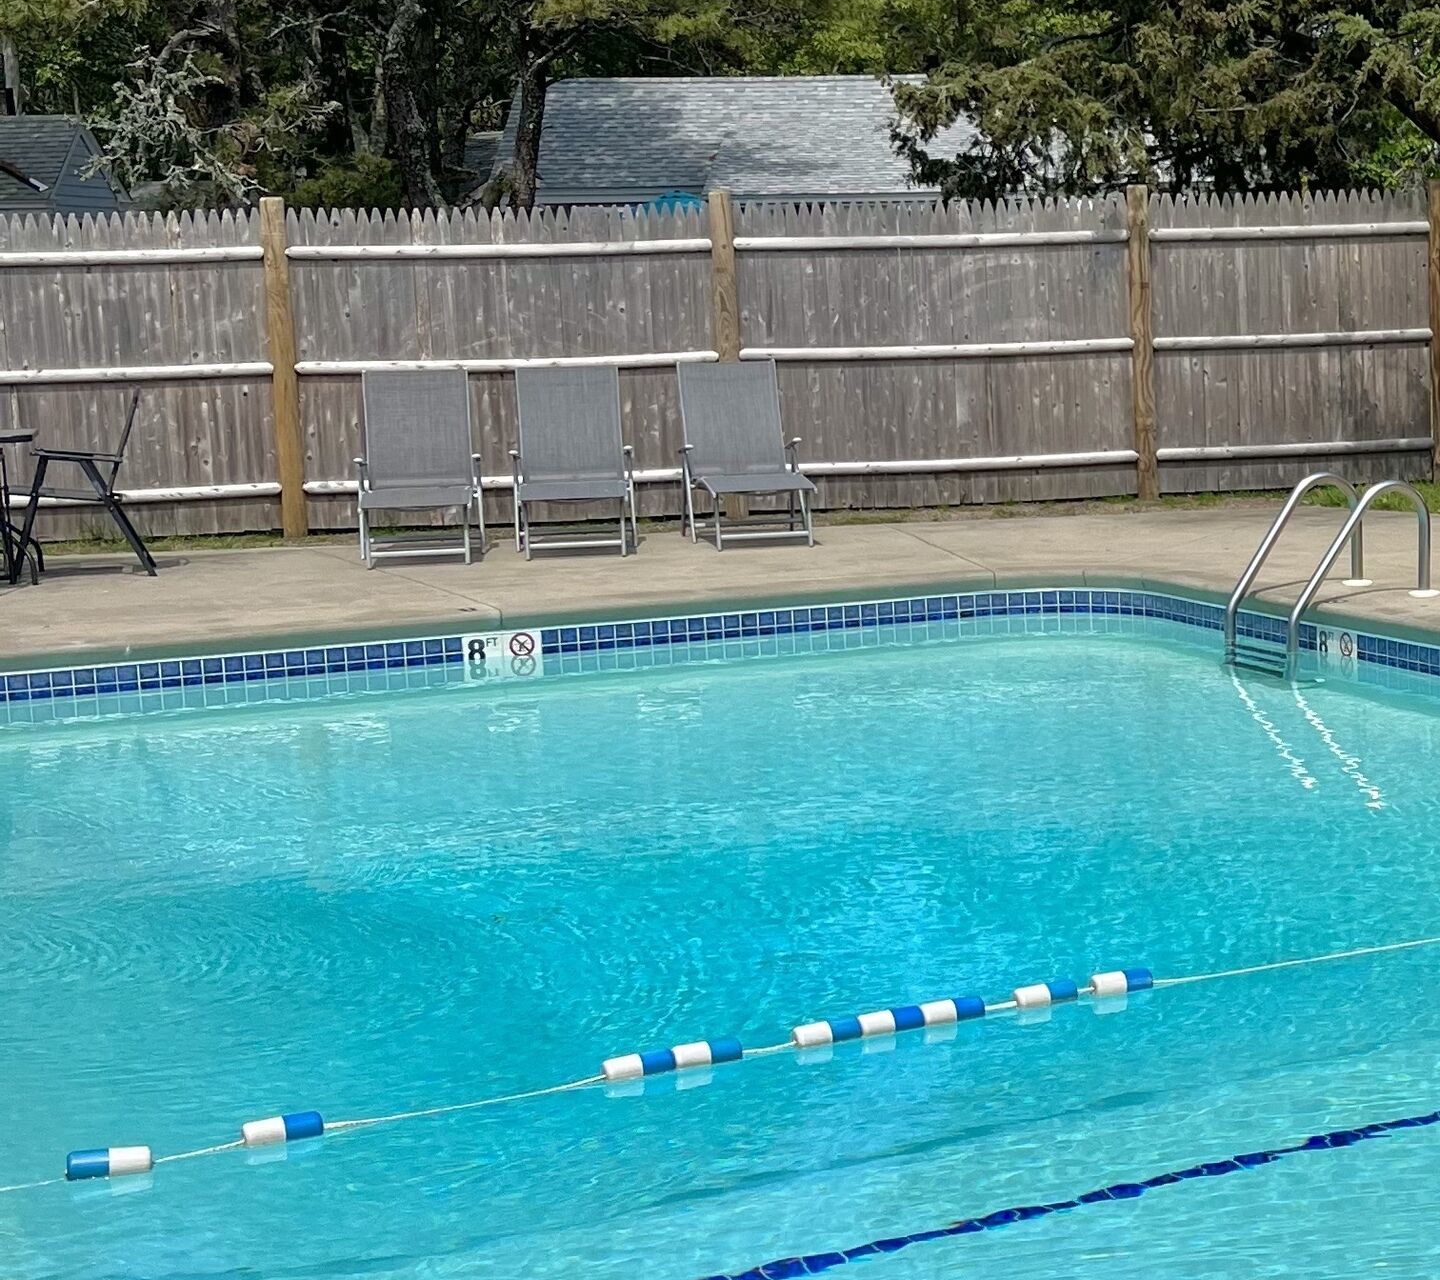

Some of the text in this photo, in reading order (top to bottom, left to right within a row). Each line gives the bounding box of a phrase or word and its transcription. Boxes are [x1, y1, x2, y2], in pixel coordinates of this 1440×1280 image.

[468, 637, 498, 661] 8 FT
[1319, 630, 1328, 653] 8
